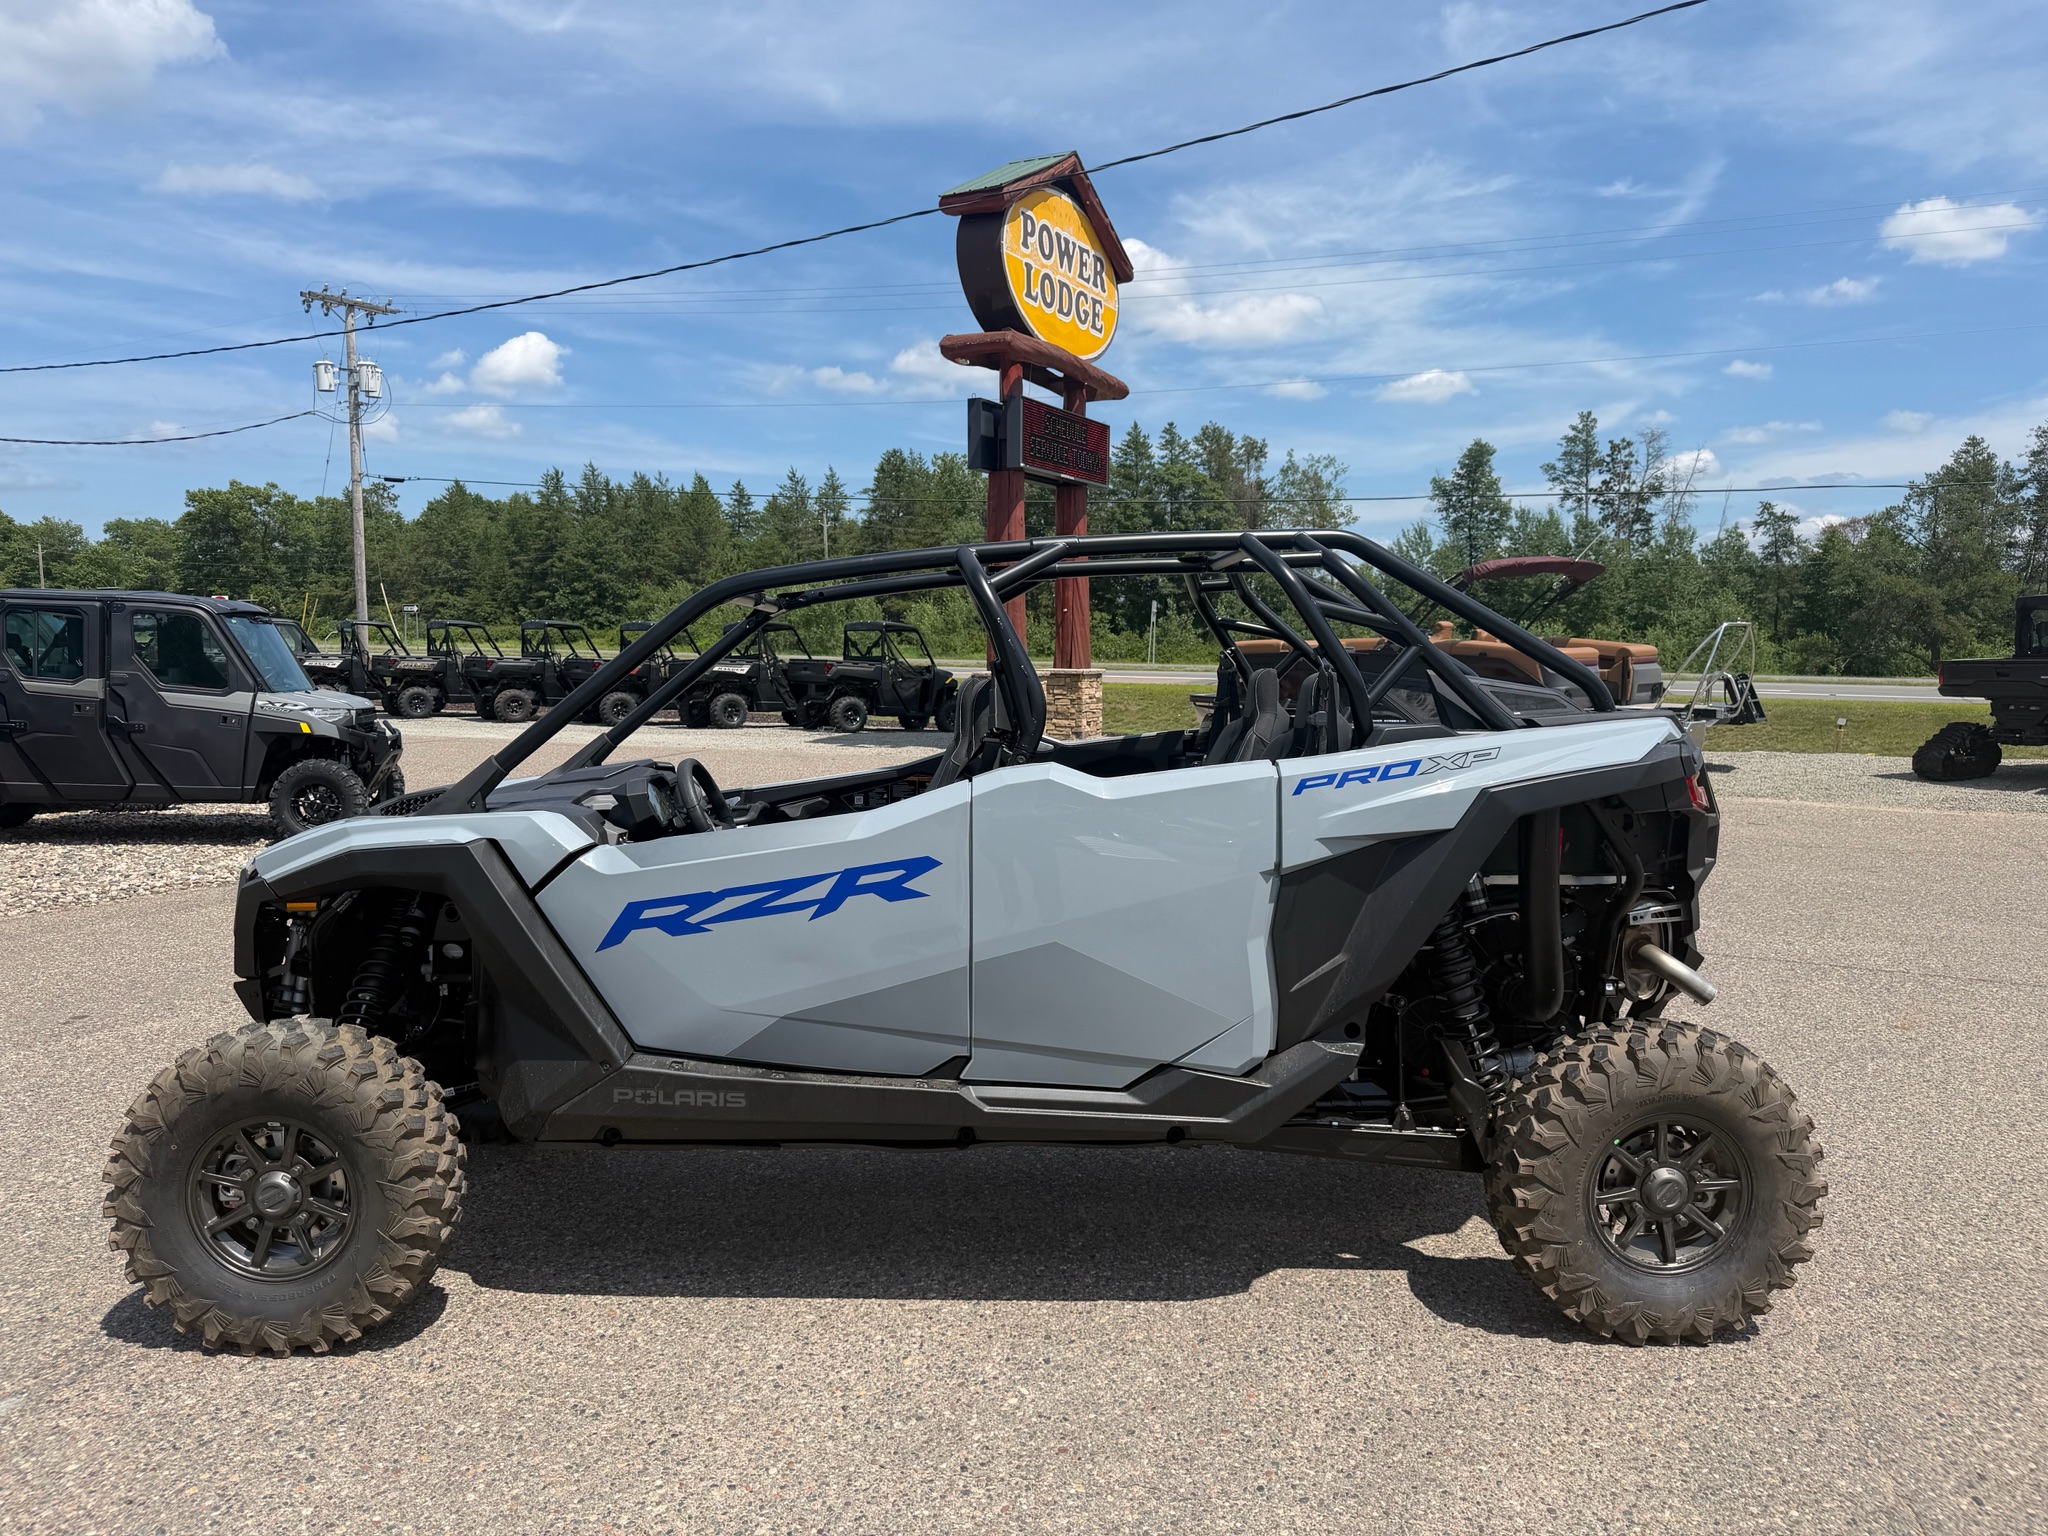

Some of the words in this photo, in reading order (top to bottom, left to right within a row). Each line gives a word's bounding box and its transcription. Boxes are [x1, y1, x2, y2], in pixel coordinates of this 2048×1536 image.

[1020, 209, 1107, 293] POWER
[1023, 260, 1104, 336] LODGE
[1292, 758, 1423, 796] PRO
[1418, 747, 1502, 776] XP
[595, 855, 943, 953] RZR
[612, 1088, 747, 1108] POLARIS
